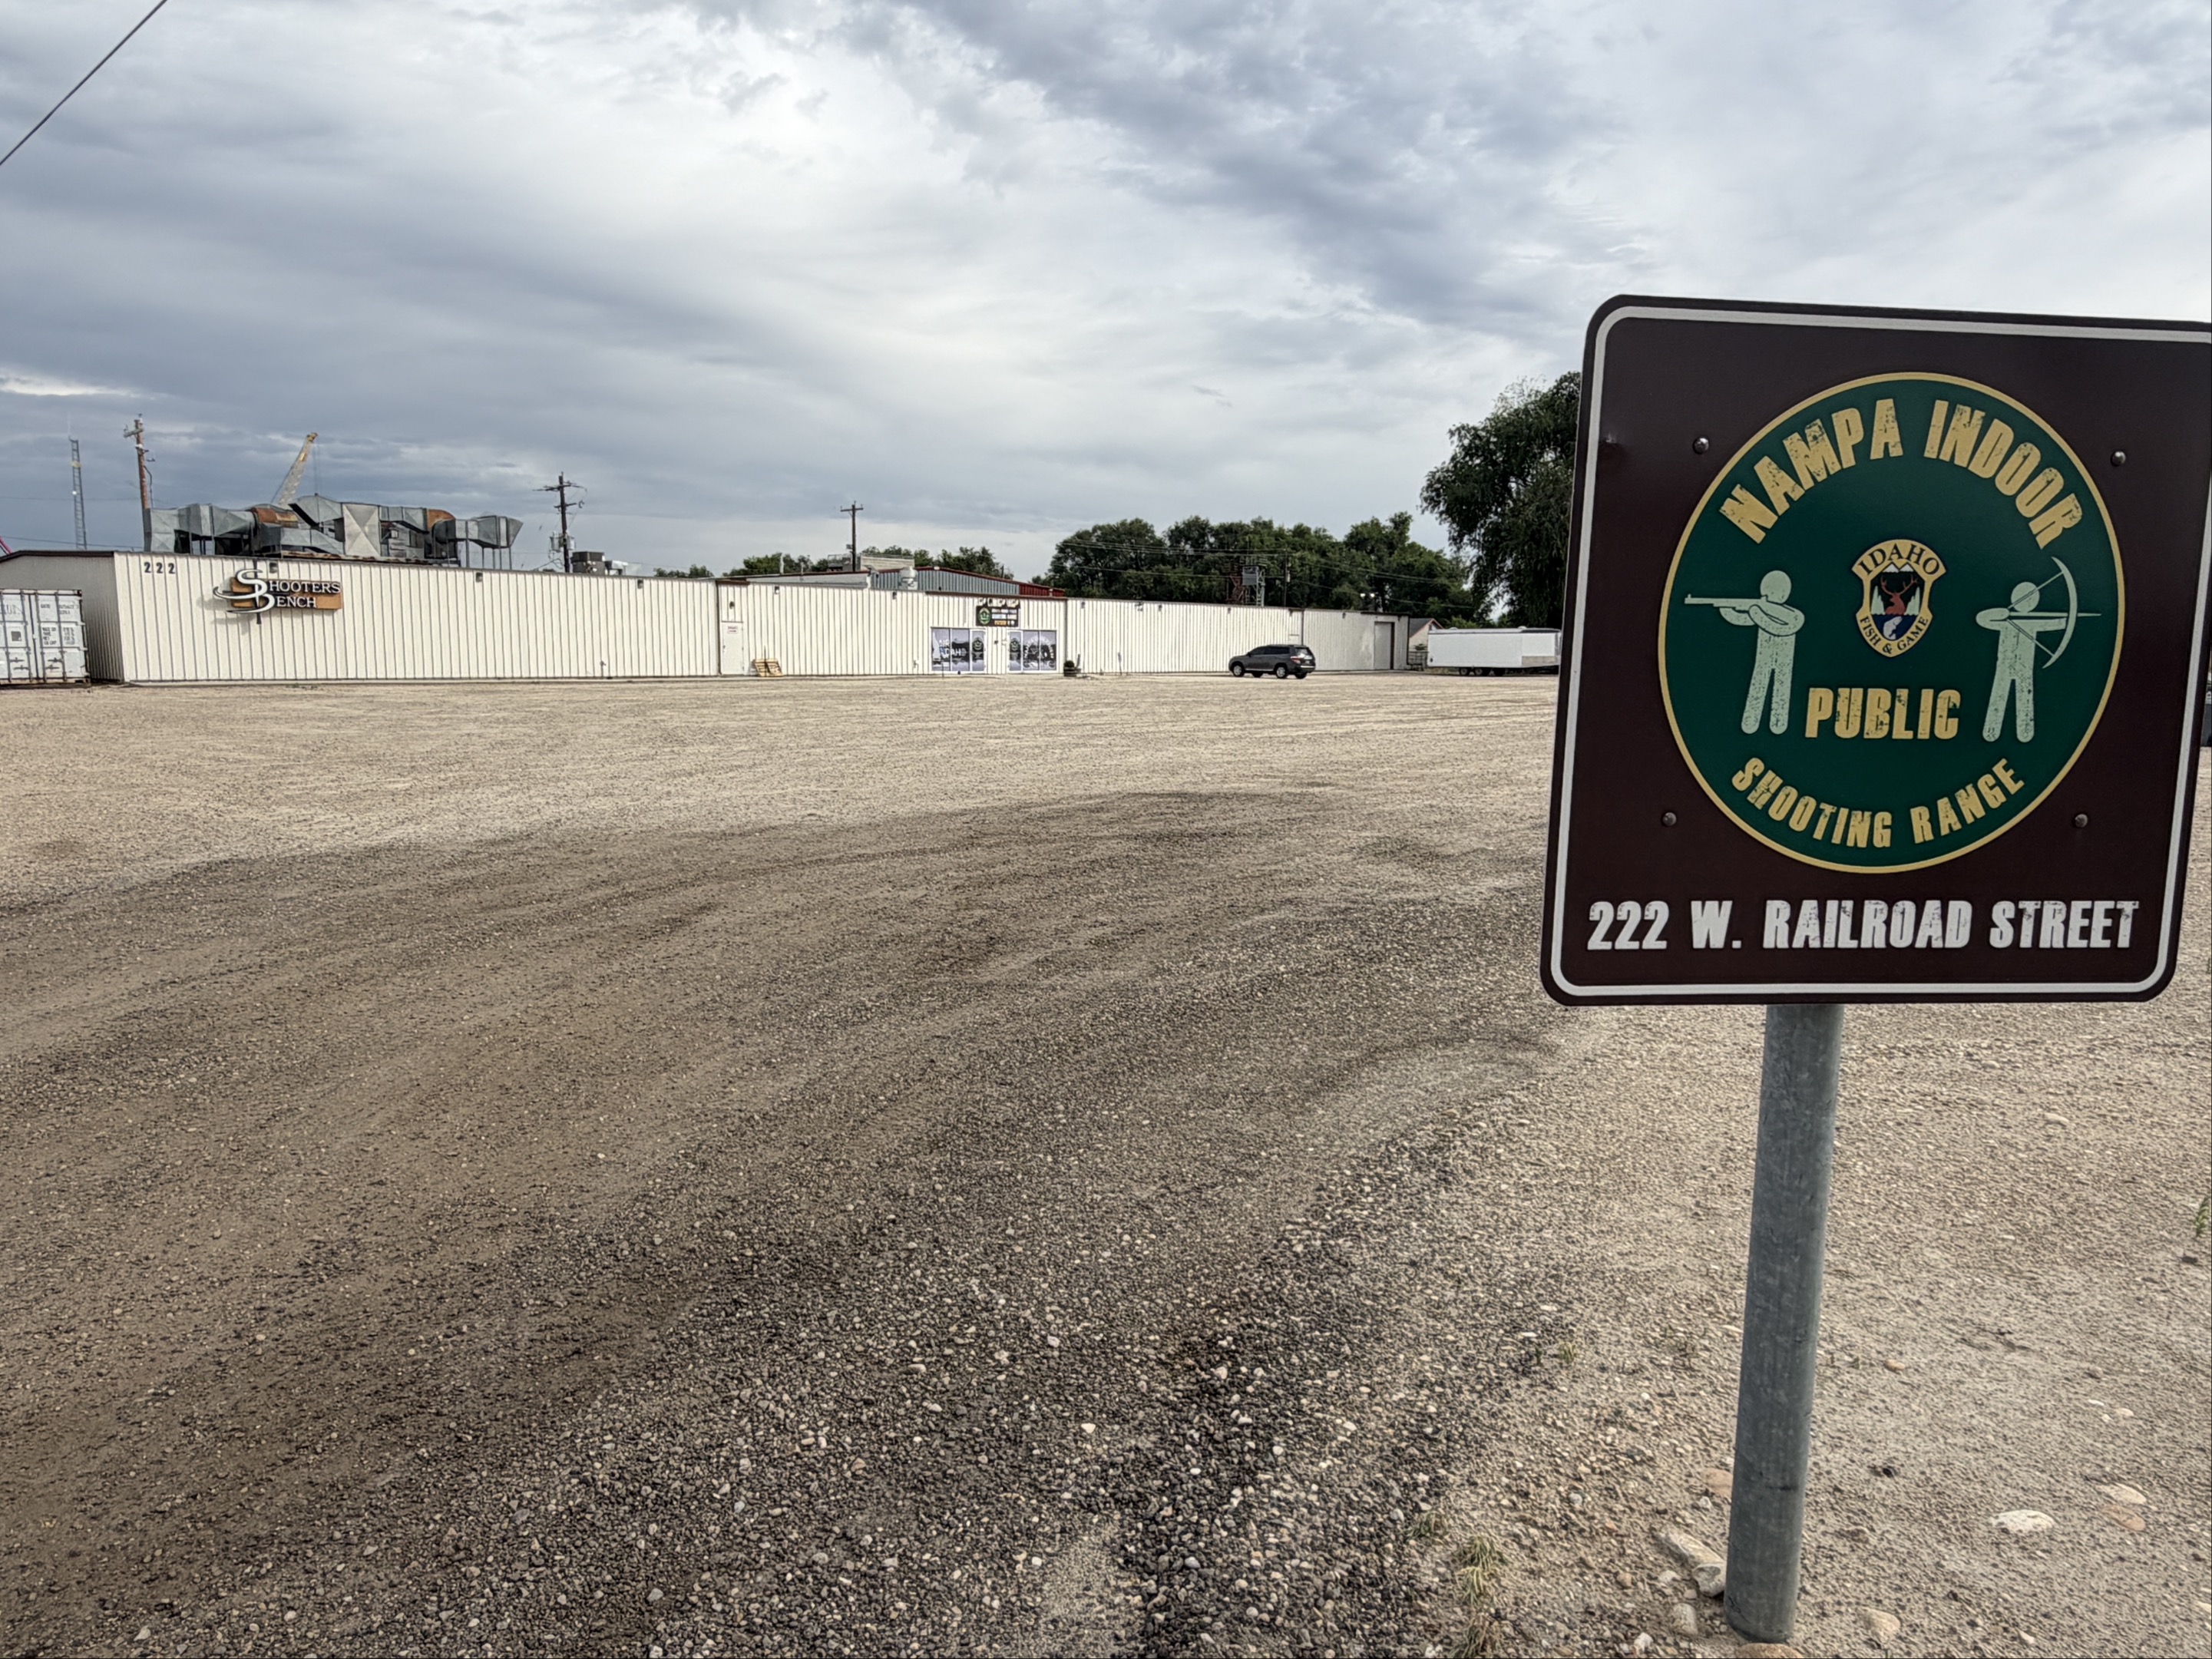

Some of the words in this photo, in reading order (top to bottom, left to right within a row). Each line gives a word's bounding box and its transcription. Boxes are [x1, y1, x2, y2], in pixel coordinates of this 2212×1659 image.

[1719, 398, 1903, 544] NAMPA
[1923, 400, 2082, 549] INDOOR
[1858, 544, 1939, 575] IDAHO
[214, 569, 340, 599] SHOOTERS
[230, 590, 316, 613] BENCH
[1860, 616, 1881, 646] FISH
[1882, 643, 1893, 654] &
[1896, 616, 1929, 650] GAME
[1805, 688, 1961, 739] PUBLIC
[1731, 758, 1893, 848] SHOOTING
[1909, 758, 2025, 844] RANGE
[1586, 900, 1670, 950] 222
[1689, 901, 1742, 949] W.
[1763, 900, 1973, 949] RAILROAD
[1989, 900, 2140, 949] STREET
